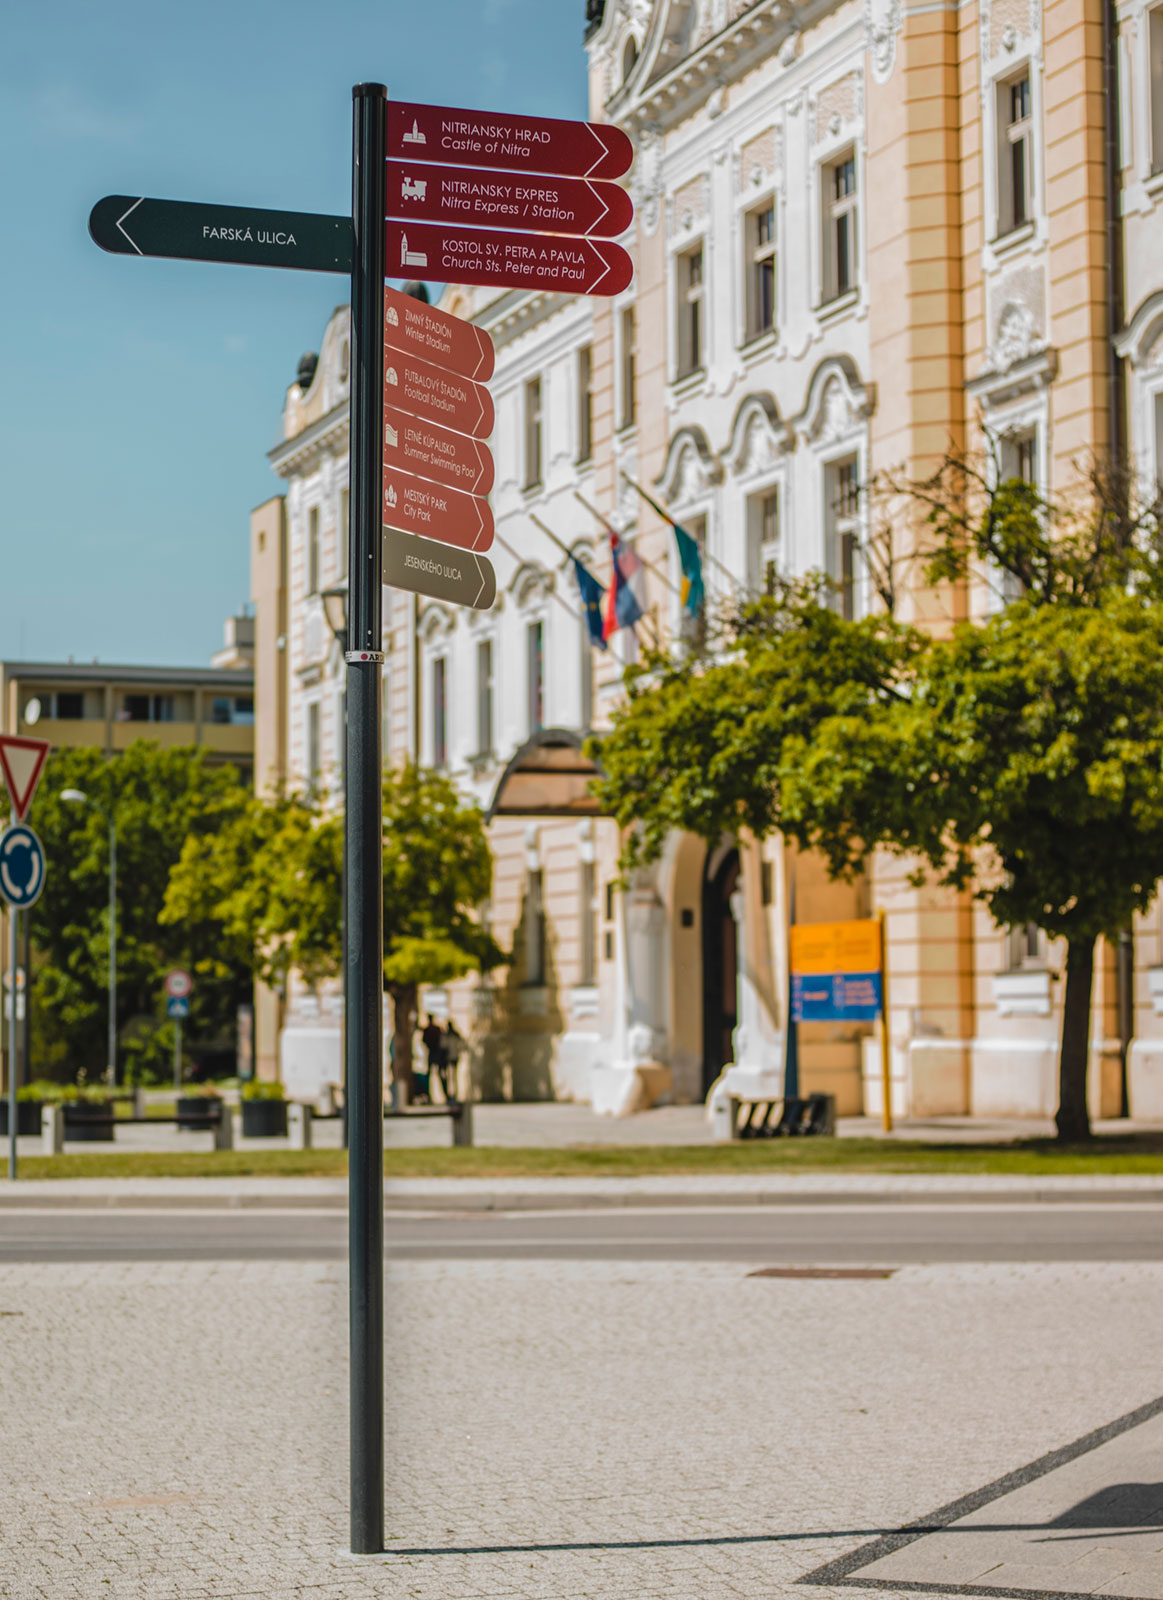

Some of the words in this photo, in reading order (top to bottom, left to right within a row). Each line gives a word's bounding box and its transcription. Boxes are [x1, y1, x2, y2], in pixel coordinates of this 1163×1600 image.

[442, 122, 511, 139] NITRIANSKY
[516, 130, 550, 144] HRAD
[442, 137, 481, 151] Castle
[485, 141, 497, 153] of
[501, 144, 530, 157] Nitra
[442, 181, 511, 198] NITRIANSKY
[516, 188, 558, 202] EXPRES
[442, 197, 470, 209] Nitra
[475, 199, 519, 214] Express
[532, 205, 574, 220] Station
[203, 226, 253, 243] FARSKÁ
[258, 231, 296, 246] ULICA
[442, 240, 483, 255] KOSTOL
[486, 244, 502, 256] SV.
[505, 246, 536, 259] PETRA
[540, 249, 547, 260] A
[551, 250, 585, 264] PAVLA
[442, 255, 482, 270] Church
[485, 259, 502, 272] Sts.
[505, 262, 534, 275] Peter
[537, 265, 558, 276] and
[562, 267, 585, 279] Paul
[405, 309, 424, 326] ZIMNÝ
[426, 317, 452, 338] ŠTADIÓN
[406, 325, 425, 341] Winter
[426, 334, 450, 353] Stadium
[405, 369, 439, 392] FUTBALOVÝ
[441, 381, 466, 402] ŠTADIÓN
[405, 385, 430, 403] Football
[431, 394, 455, 413] Stadium
[404, 428, 422, 444] LETNÉ
[423, 435, 455, 456] KÚPALISKO
[404, 444, 429, 462] Summer
[431, 454, 460, 476] Swimming
[462, 465, 475, 478] Pool
[404, 489, 430, 505] MESTSKÝ
[431, 497, 447, 512] PARK
[404, 504, 416, 519] City
[418, 509, 431, 521] Park
[404, 555, 442, 575] JESENSKÉHO
[444, 566, 462, 580] ULICA
